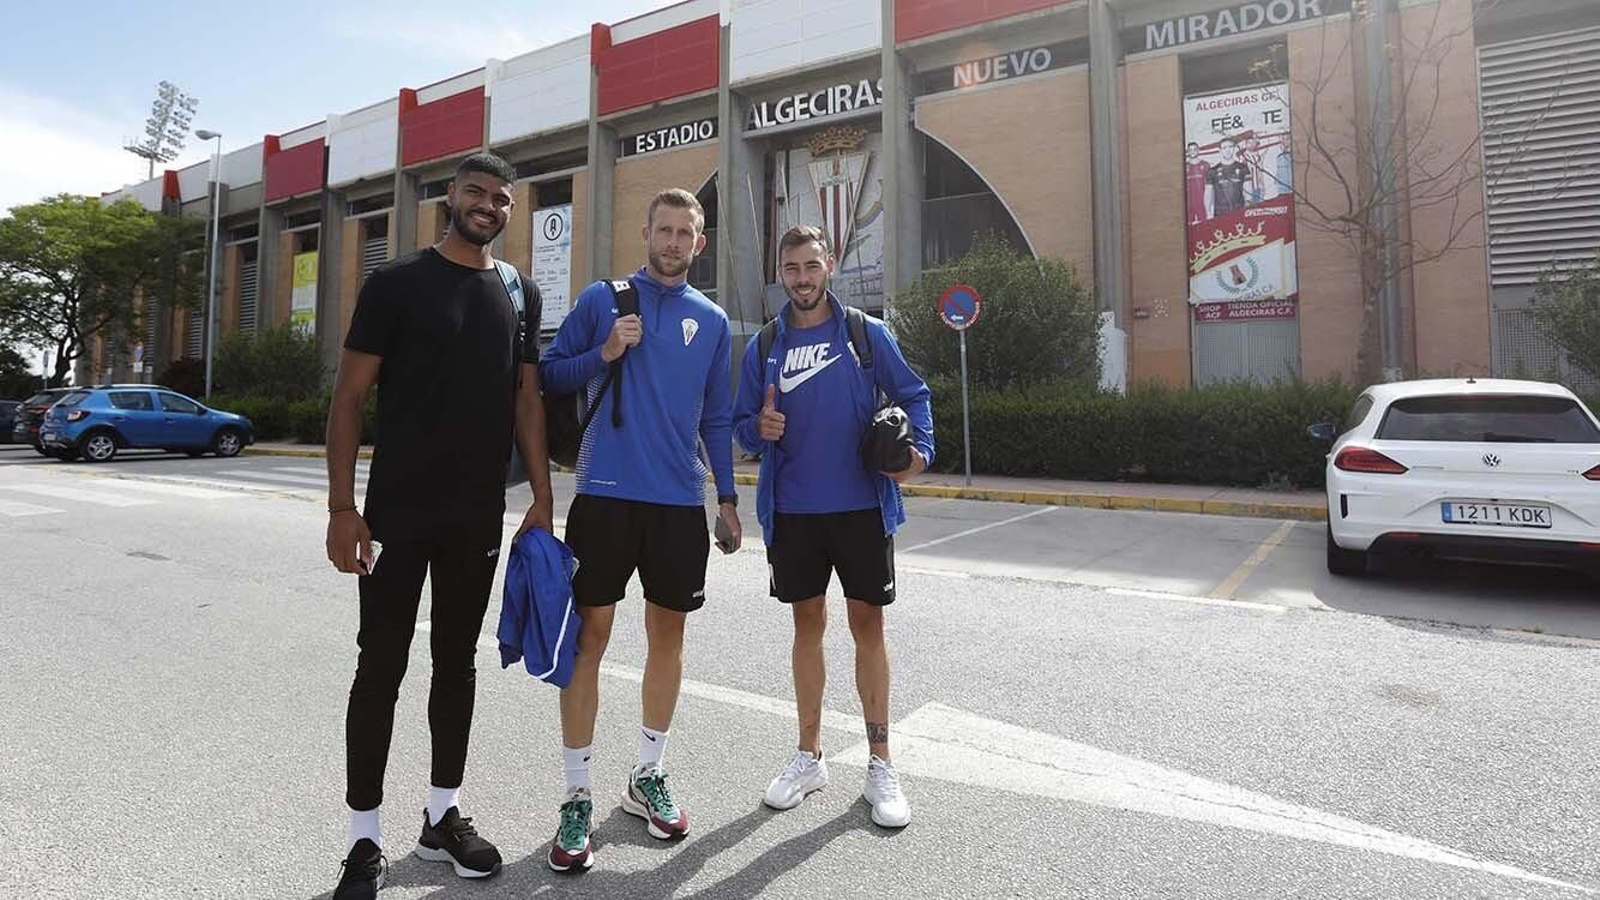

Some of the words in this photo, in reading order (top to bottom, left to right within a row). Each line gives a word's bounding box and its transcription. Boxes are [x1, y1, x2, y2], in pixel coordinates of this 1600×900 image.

[1146, 0, 1321, 49] MIRADOR
[953, 48, 1052, 87] NUEVO
[1196, 94, 1258, 111] ALGECIRAS
[1263, 109, 1282, 124] TE
[636, 120, 713, 153] ESTADIO
[1228, 302, 1258, 310] TIENDA
[1260, 300, 1294, 308] OFICIAL
[1229, 309, 1276, 317] ALGECIRAS
[783, 342, 831, 373] NIKE
[1459, 505, 1500, 520] 1211
[1509, 508, 1545, 523] KDK
